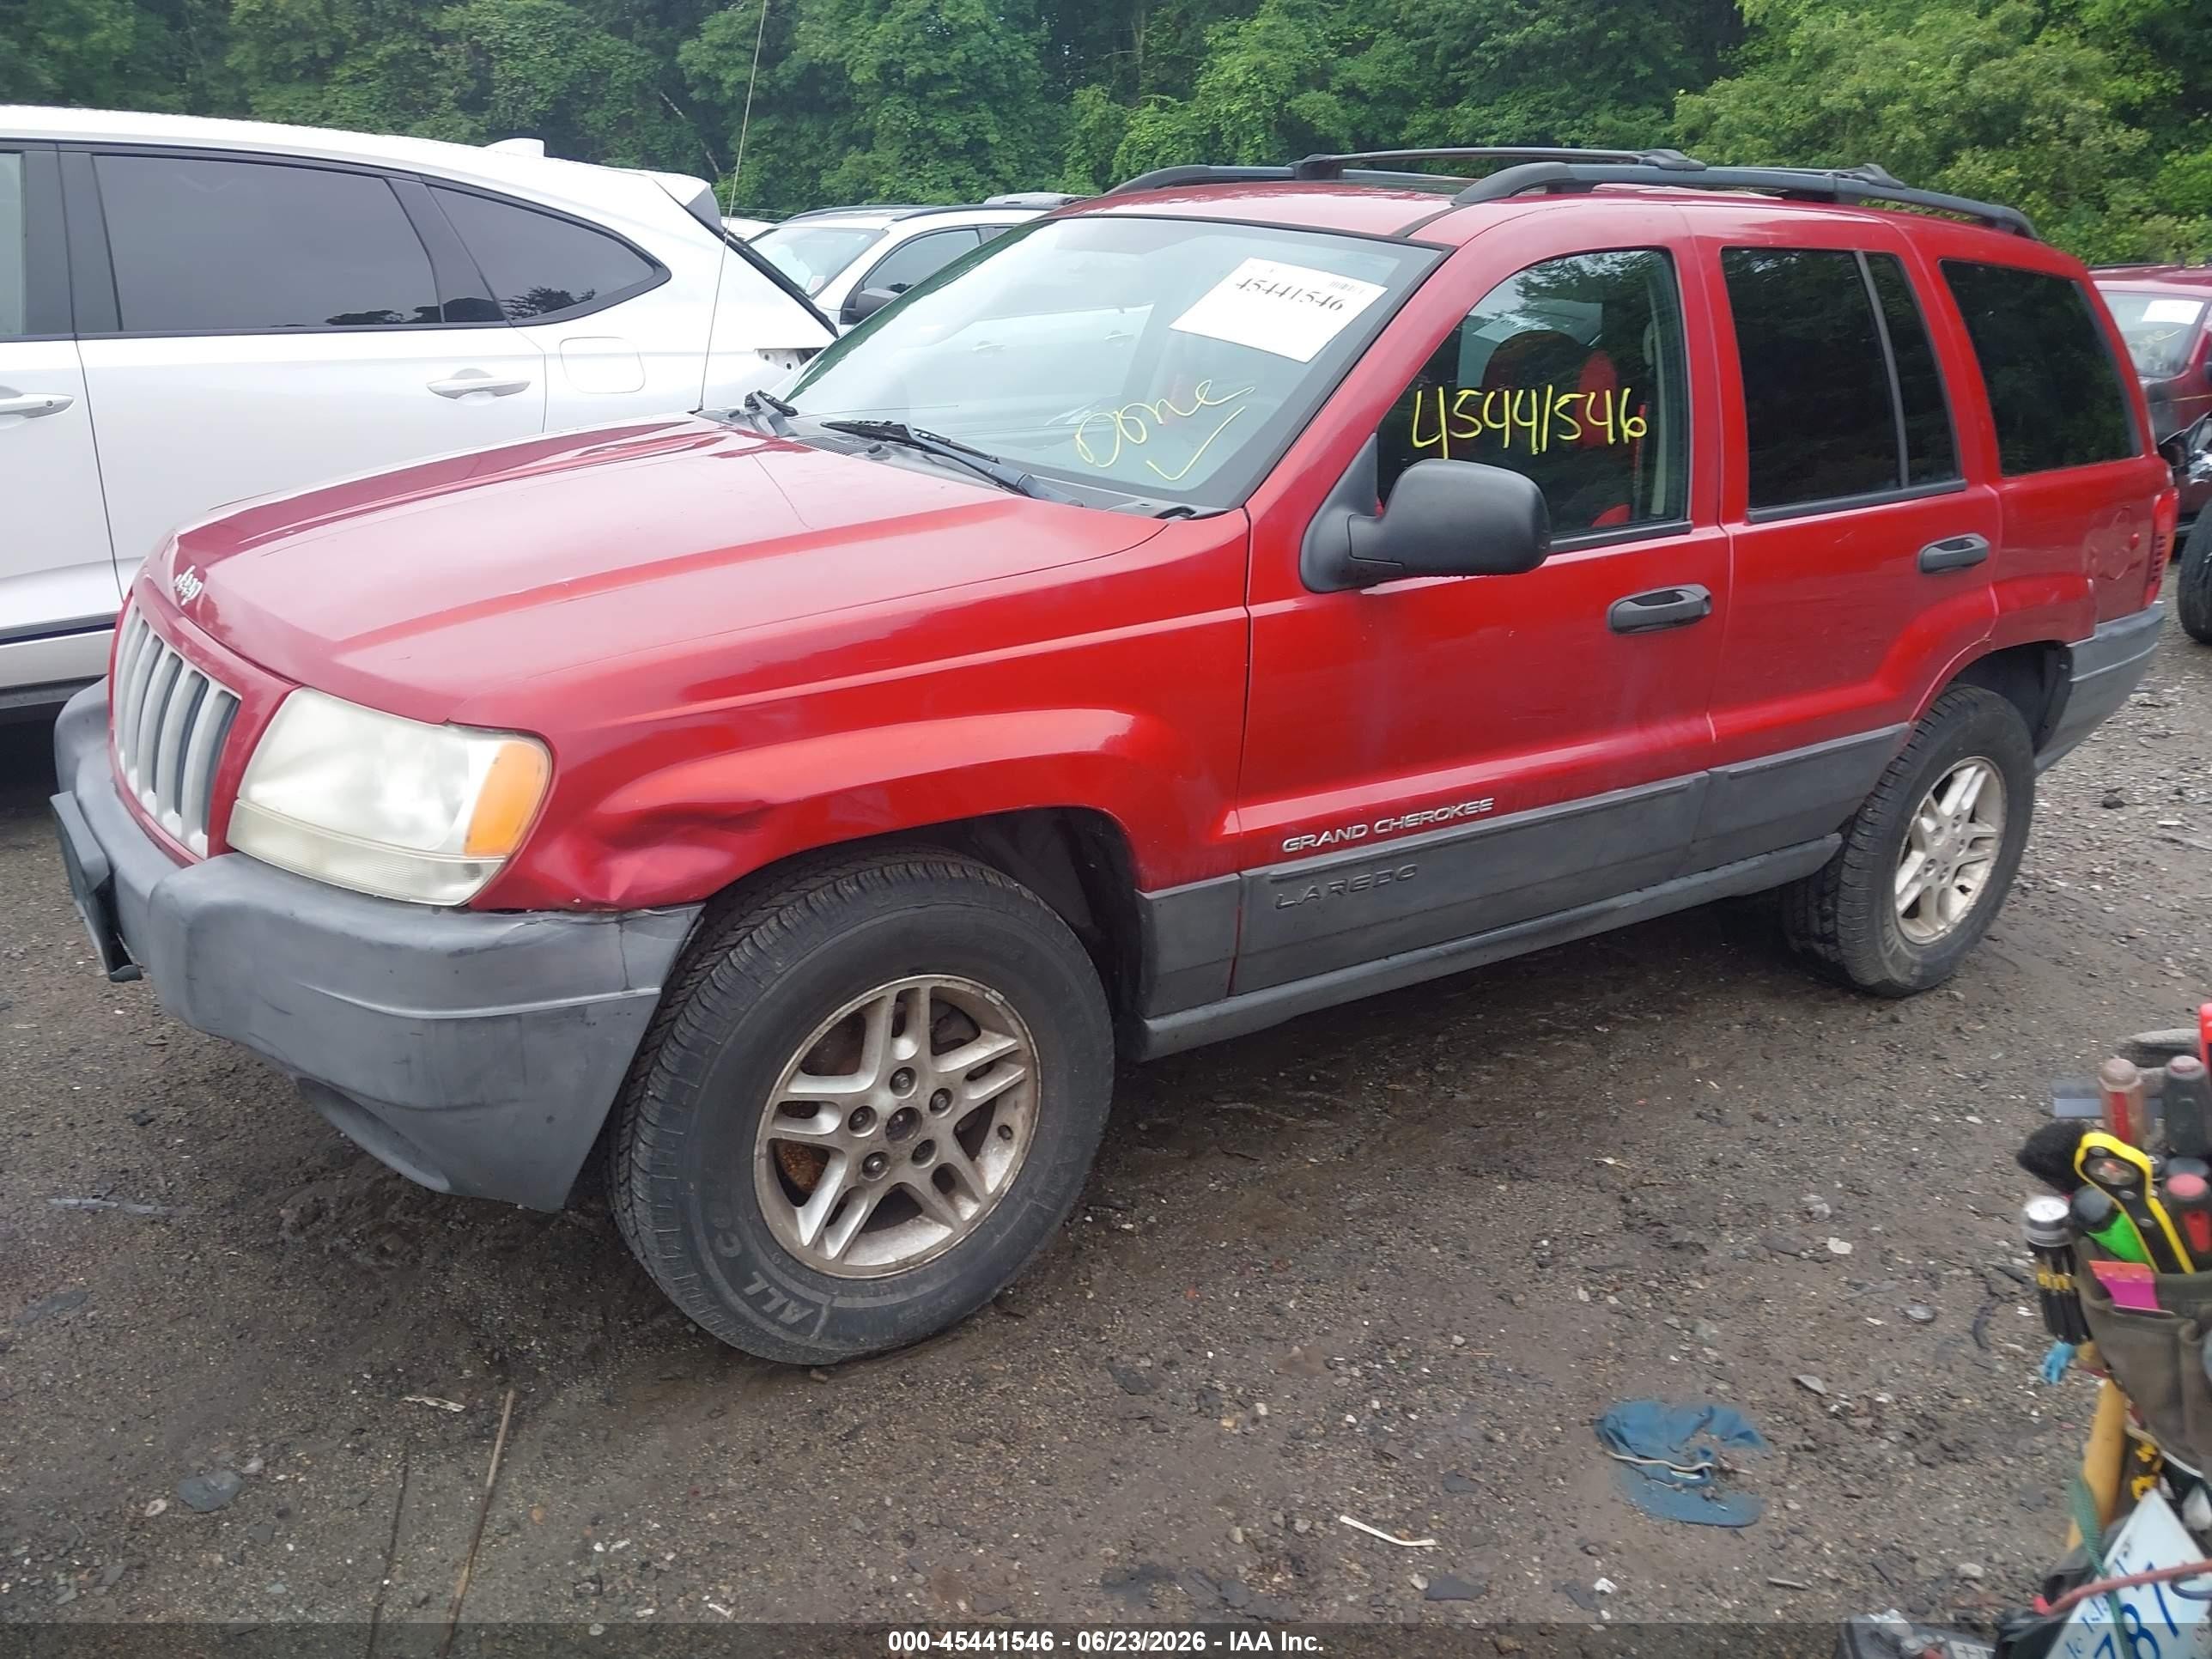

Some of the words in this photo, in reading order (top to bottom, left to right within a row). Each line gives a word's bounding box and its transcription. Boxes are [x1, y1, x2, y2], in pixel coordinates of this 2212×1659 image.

[1236, 277, 1346, 311] 45441546
[1412, 384, 1648, 459] 45441546
[174, 564, 204, 606] Jeep
[1282, 823, 1369, 853] GRAND
[1373, 797, 1495, 835] CHEROKEE
[1275, 864, 1418, 910] LAREDO
